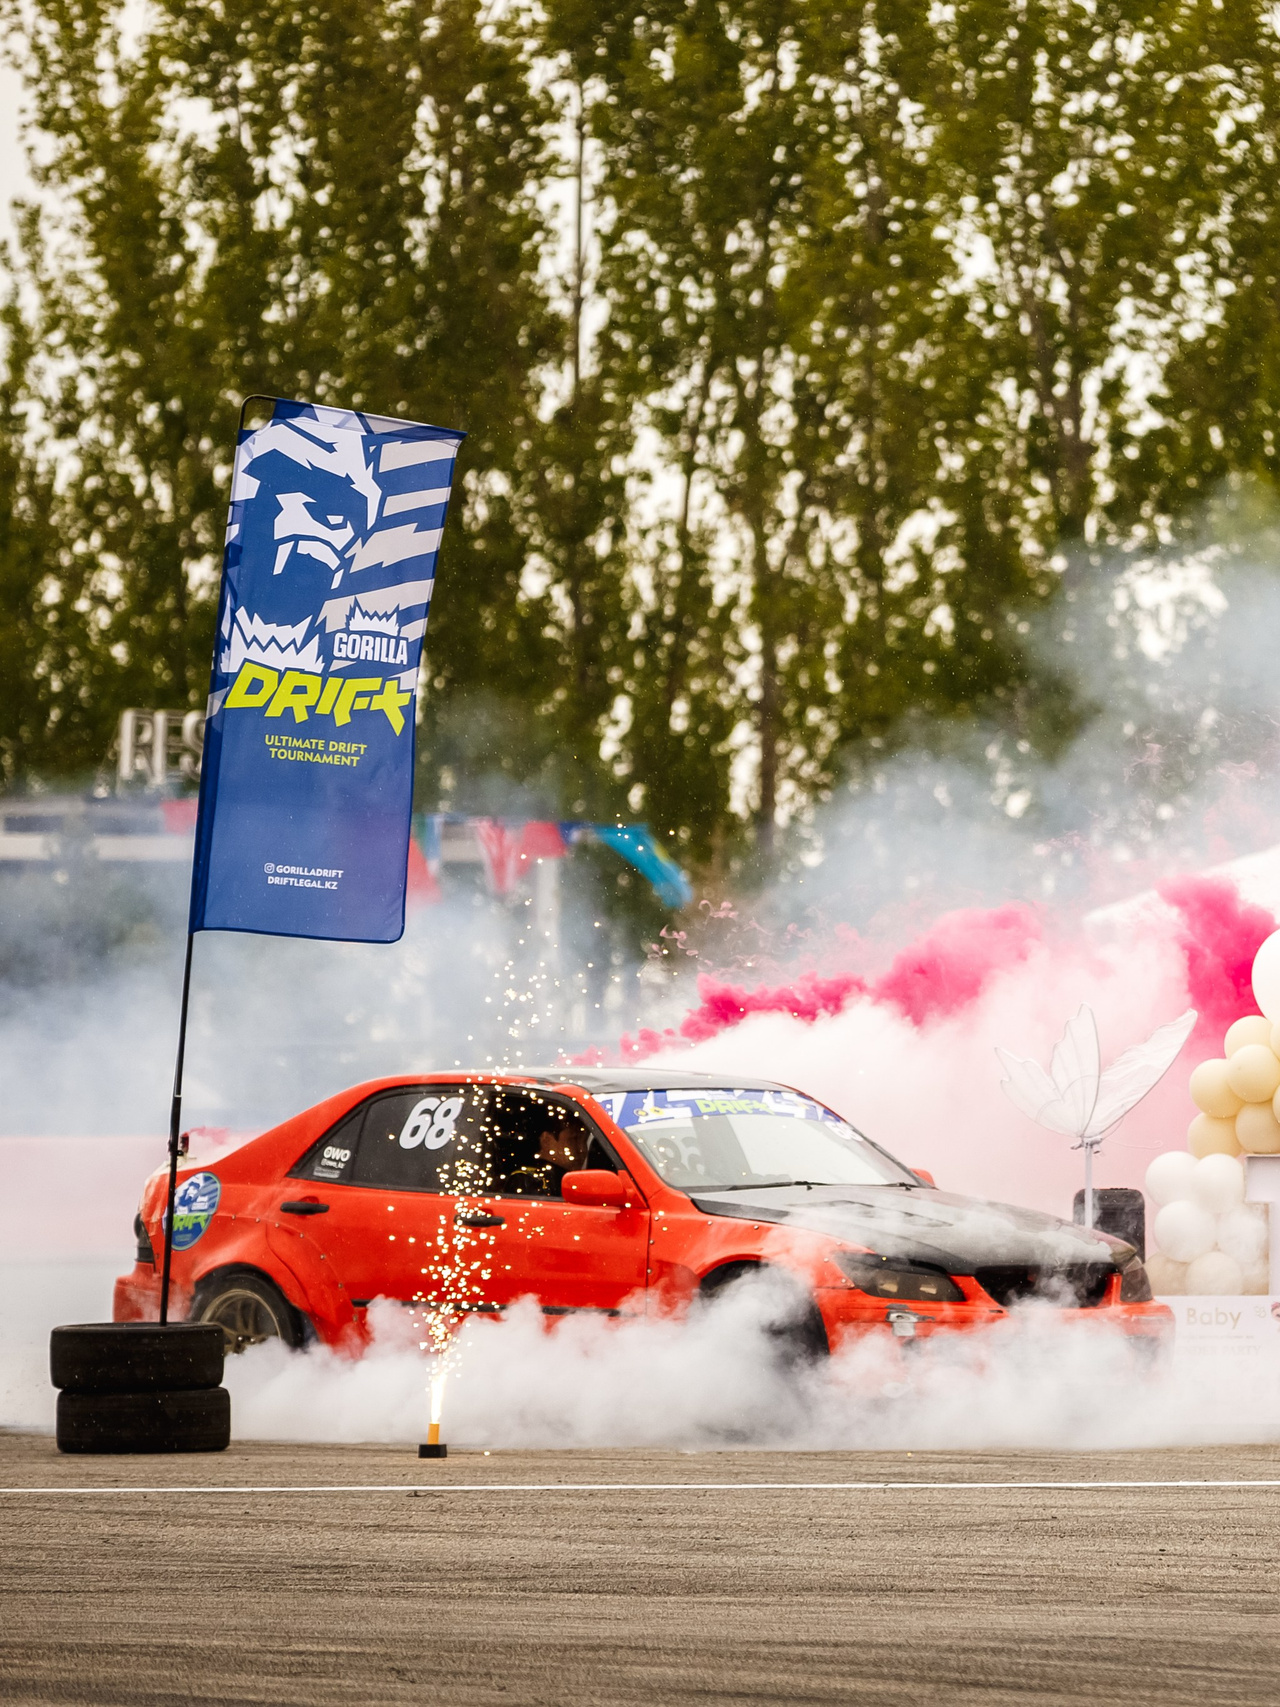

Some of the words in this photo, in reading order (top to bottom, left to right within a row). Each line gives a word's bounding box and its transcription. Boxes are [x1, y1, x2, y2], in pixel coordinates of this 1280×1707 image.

[333, 632, 408, 665] GORILLA
[223, 661, 412, 737] DRIFT
[265, 734, 325, 751] ULTIMATE
[328, 741, 368, 755] DRIFT
[269, 748, 360, 767] TOURNAMENT
[276, 864, 344, 879] GORILLADRIFT
[267, 875, 339, 890] DRIFTLEGAL.KZ
[399, 1097, 465, 1150] 68
[323, 1146, 351, 1162] OWO
[1186, 1307, 1242, 1330] Baby
